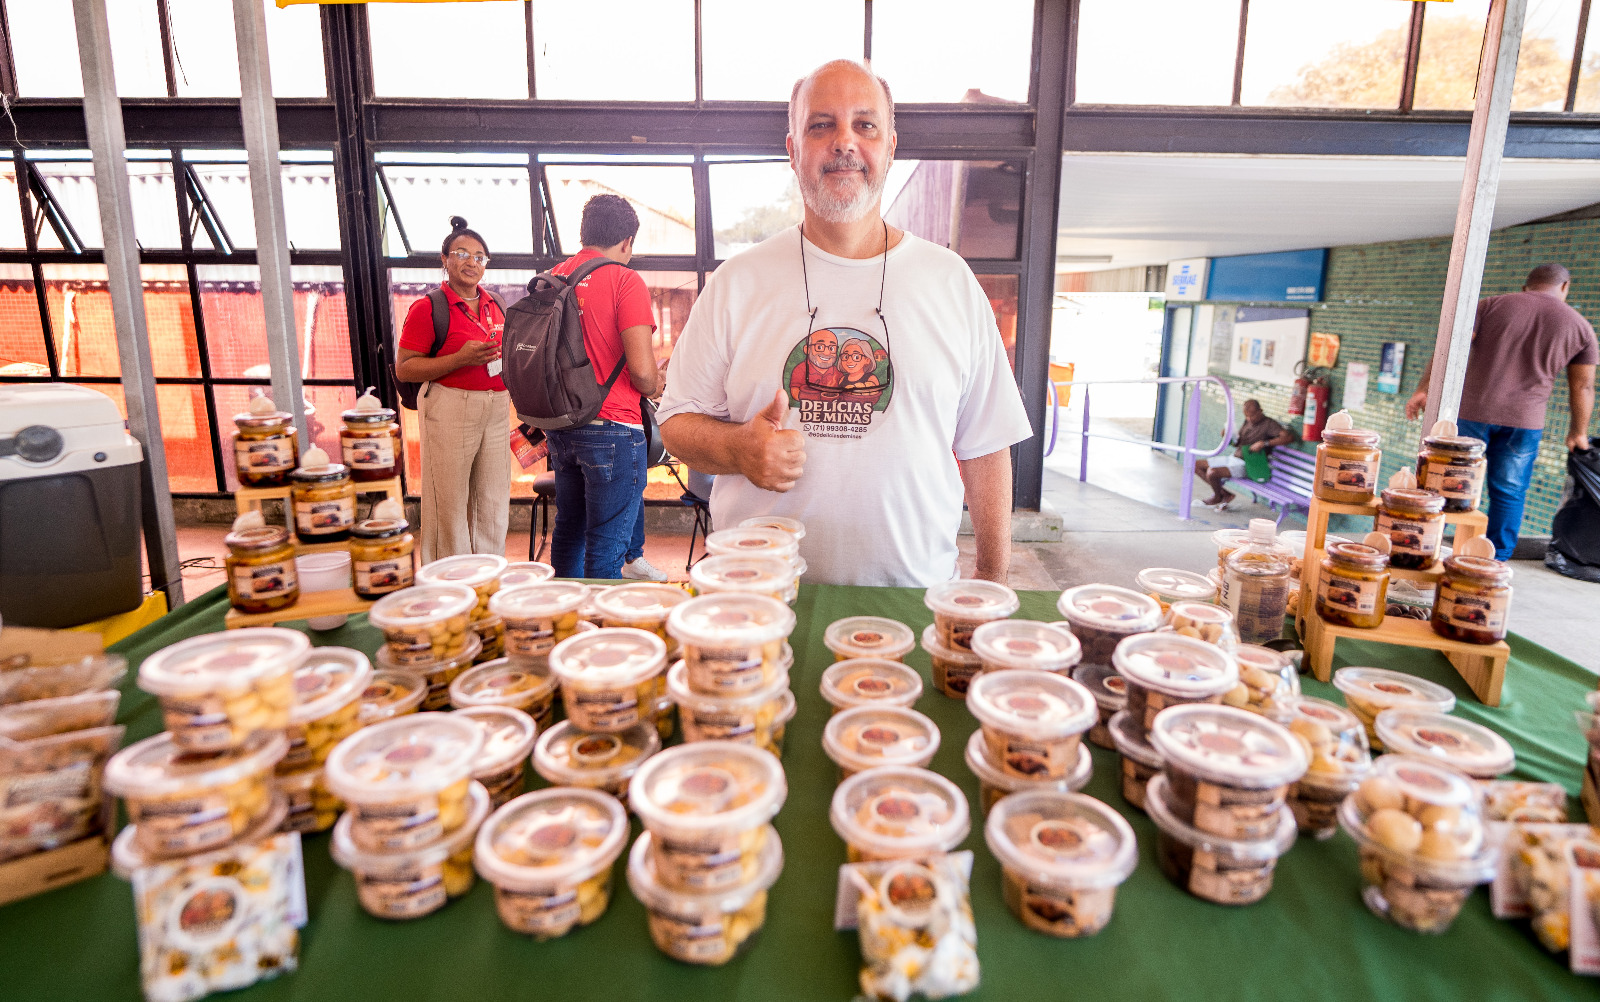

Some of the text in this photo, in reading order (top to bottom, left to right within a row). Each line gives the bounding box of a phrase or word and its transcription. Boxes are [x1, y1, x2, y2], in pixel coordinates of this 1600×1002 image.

[801, 399, 872, 414] DELÍCIAS
[802, 411, 871, 424] DE MINAS
[812, 424, 825, 432] (71)
